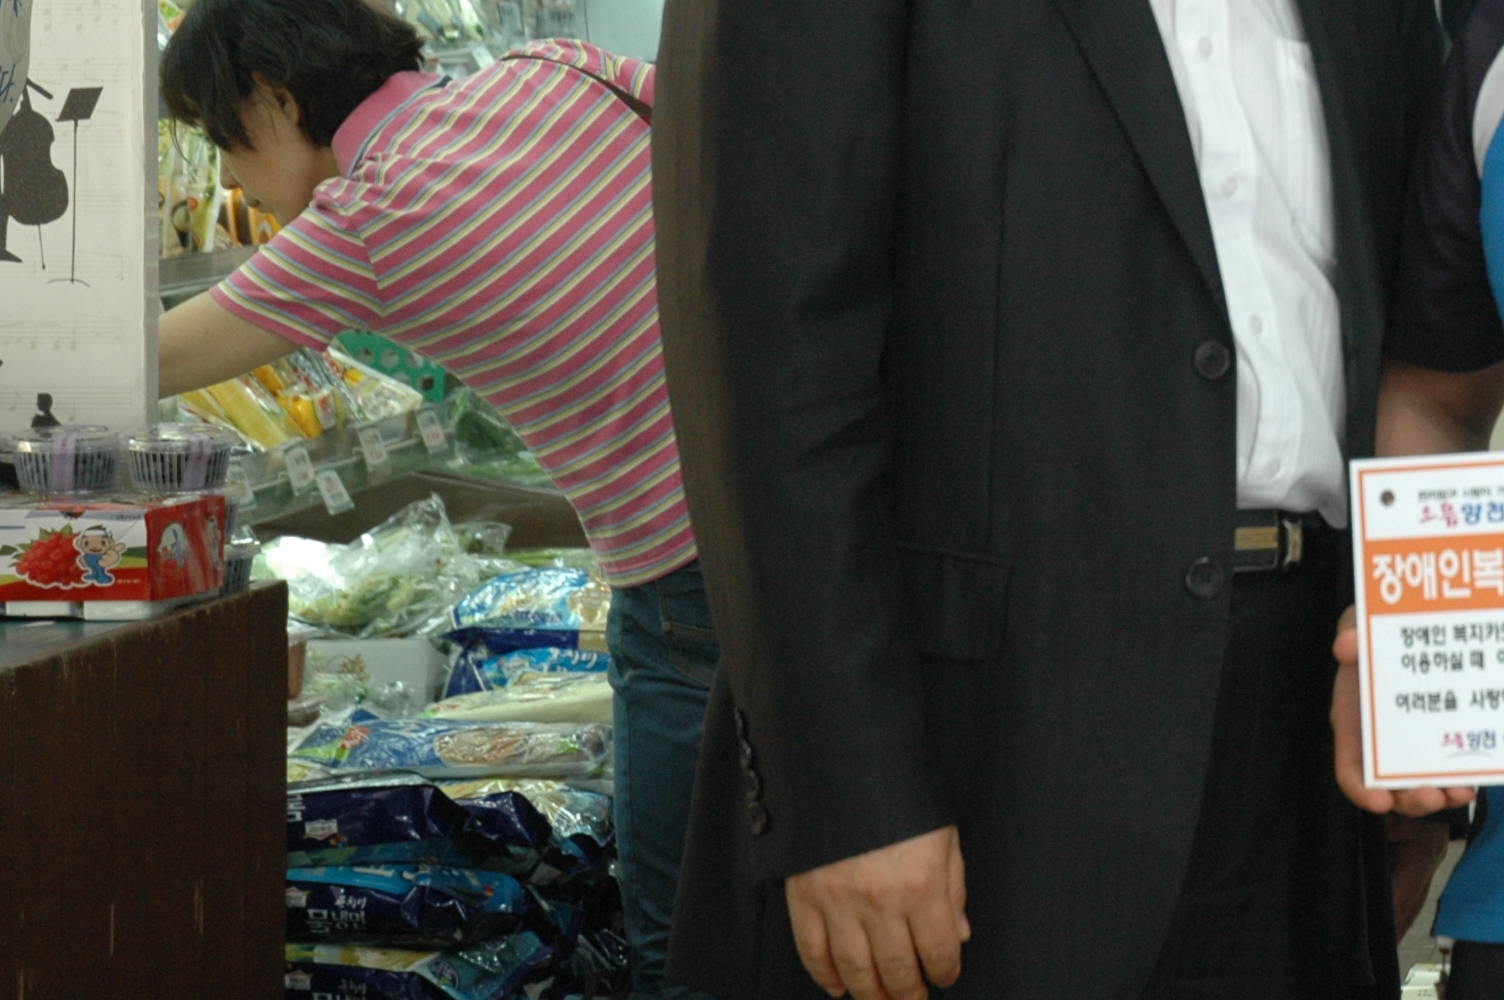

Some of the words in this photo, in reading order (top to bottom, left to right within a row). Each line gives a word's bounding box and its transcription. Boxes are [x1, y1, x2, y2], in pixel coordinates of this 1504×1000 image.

[1401, 624, 1447, 648] 장애인
[1401, 651, 1464, 674] 이용하실
[1470, 650, 1485, 671] 때
[1395, 689, 1458, 714] 여러분을
